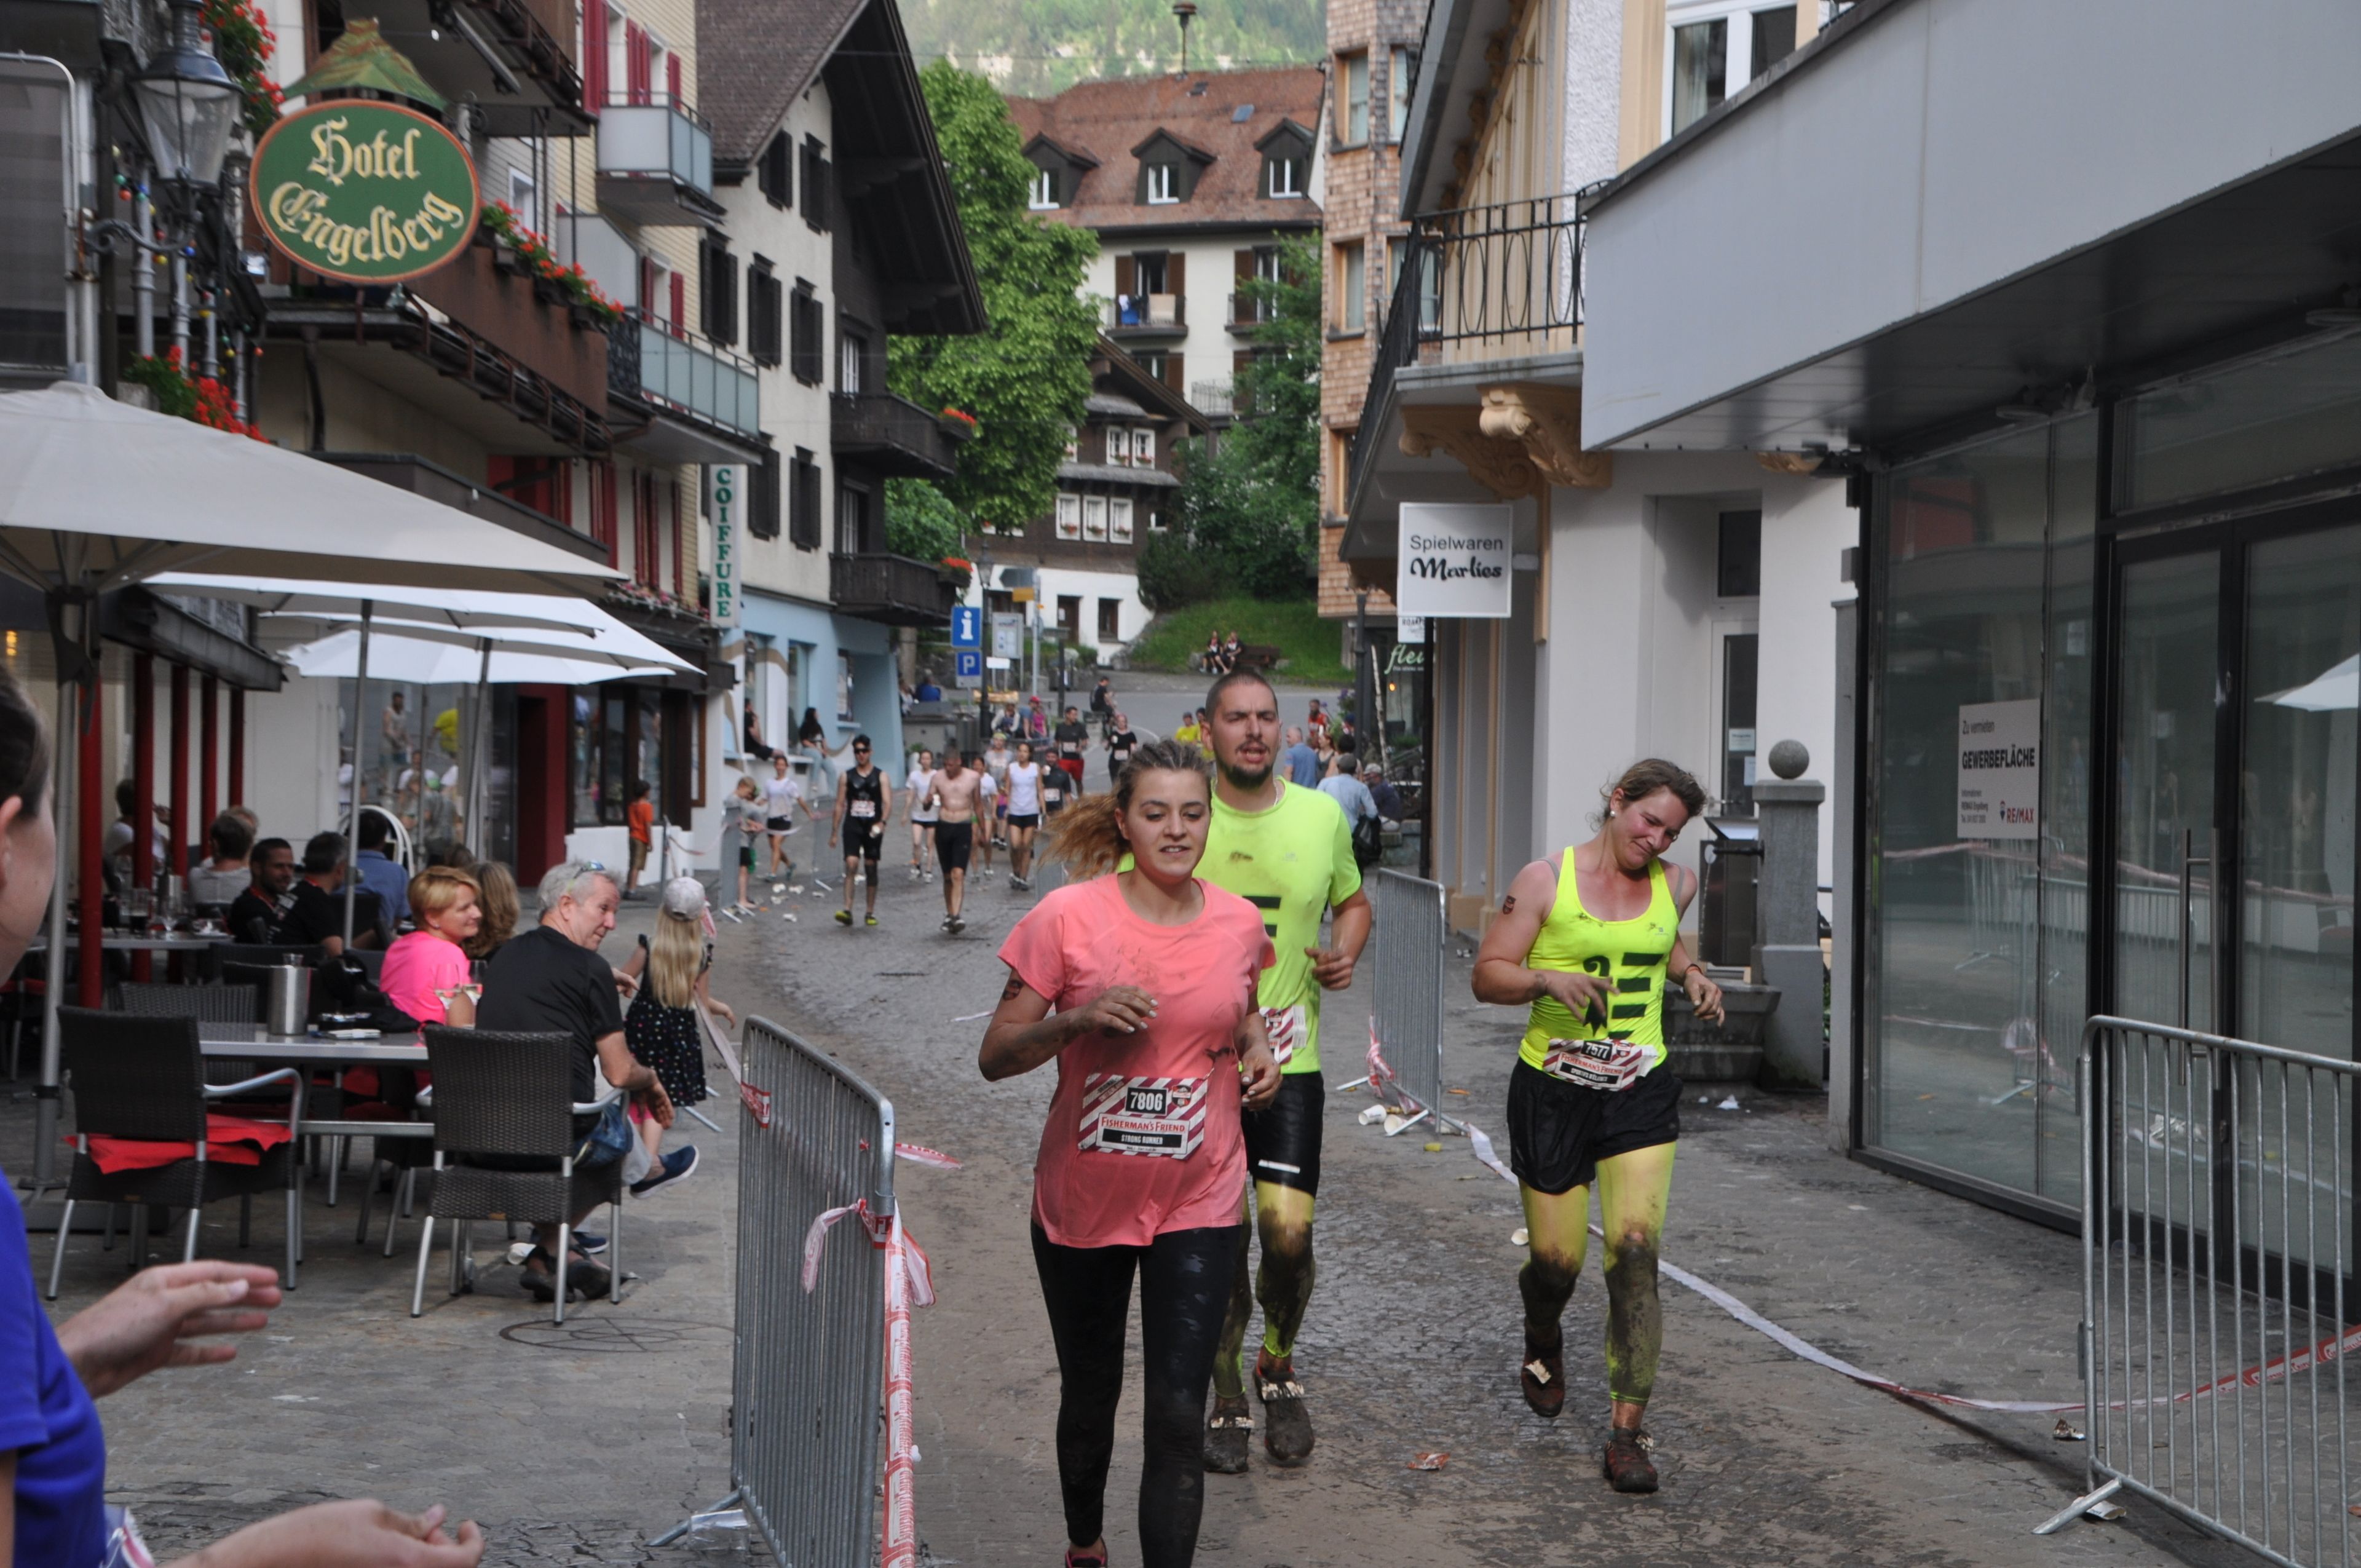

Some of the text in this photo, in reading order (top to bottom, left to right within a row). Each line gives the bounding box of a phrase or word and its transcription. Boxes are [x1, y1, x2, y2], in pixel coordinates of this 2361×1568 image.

[308, 116, 422, 186] Hotel
[269, 181, 464, 266] Engelberg
[714, 468, 732, 617] COIFFURE
[1410, 535, 1503, 553] Spielwaren
[1410, 555, 1502, 581] Marlies
[1962, 744, 2035, 769] GEWERBEFLÄCHE
[2007, 807, 2034, 823] RE/MAX
[1586, 1042, 1610, 1058] 7577
[1130, 1092, 1163, 1111] 7806
[1101, 1116, 1185, 1132] FISHERMAN'S FRIEND
[1121, 1134, 1163, 1145] STRONG RUNNER
